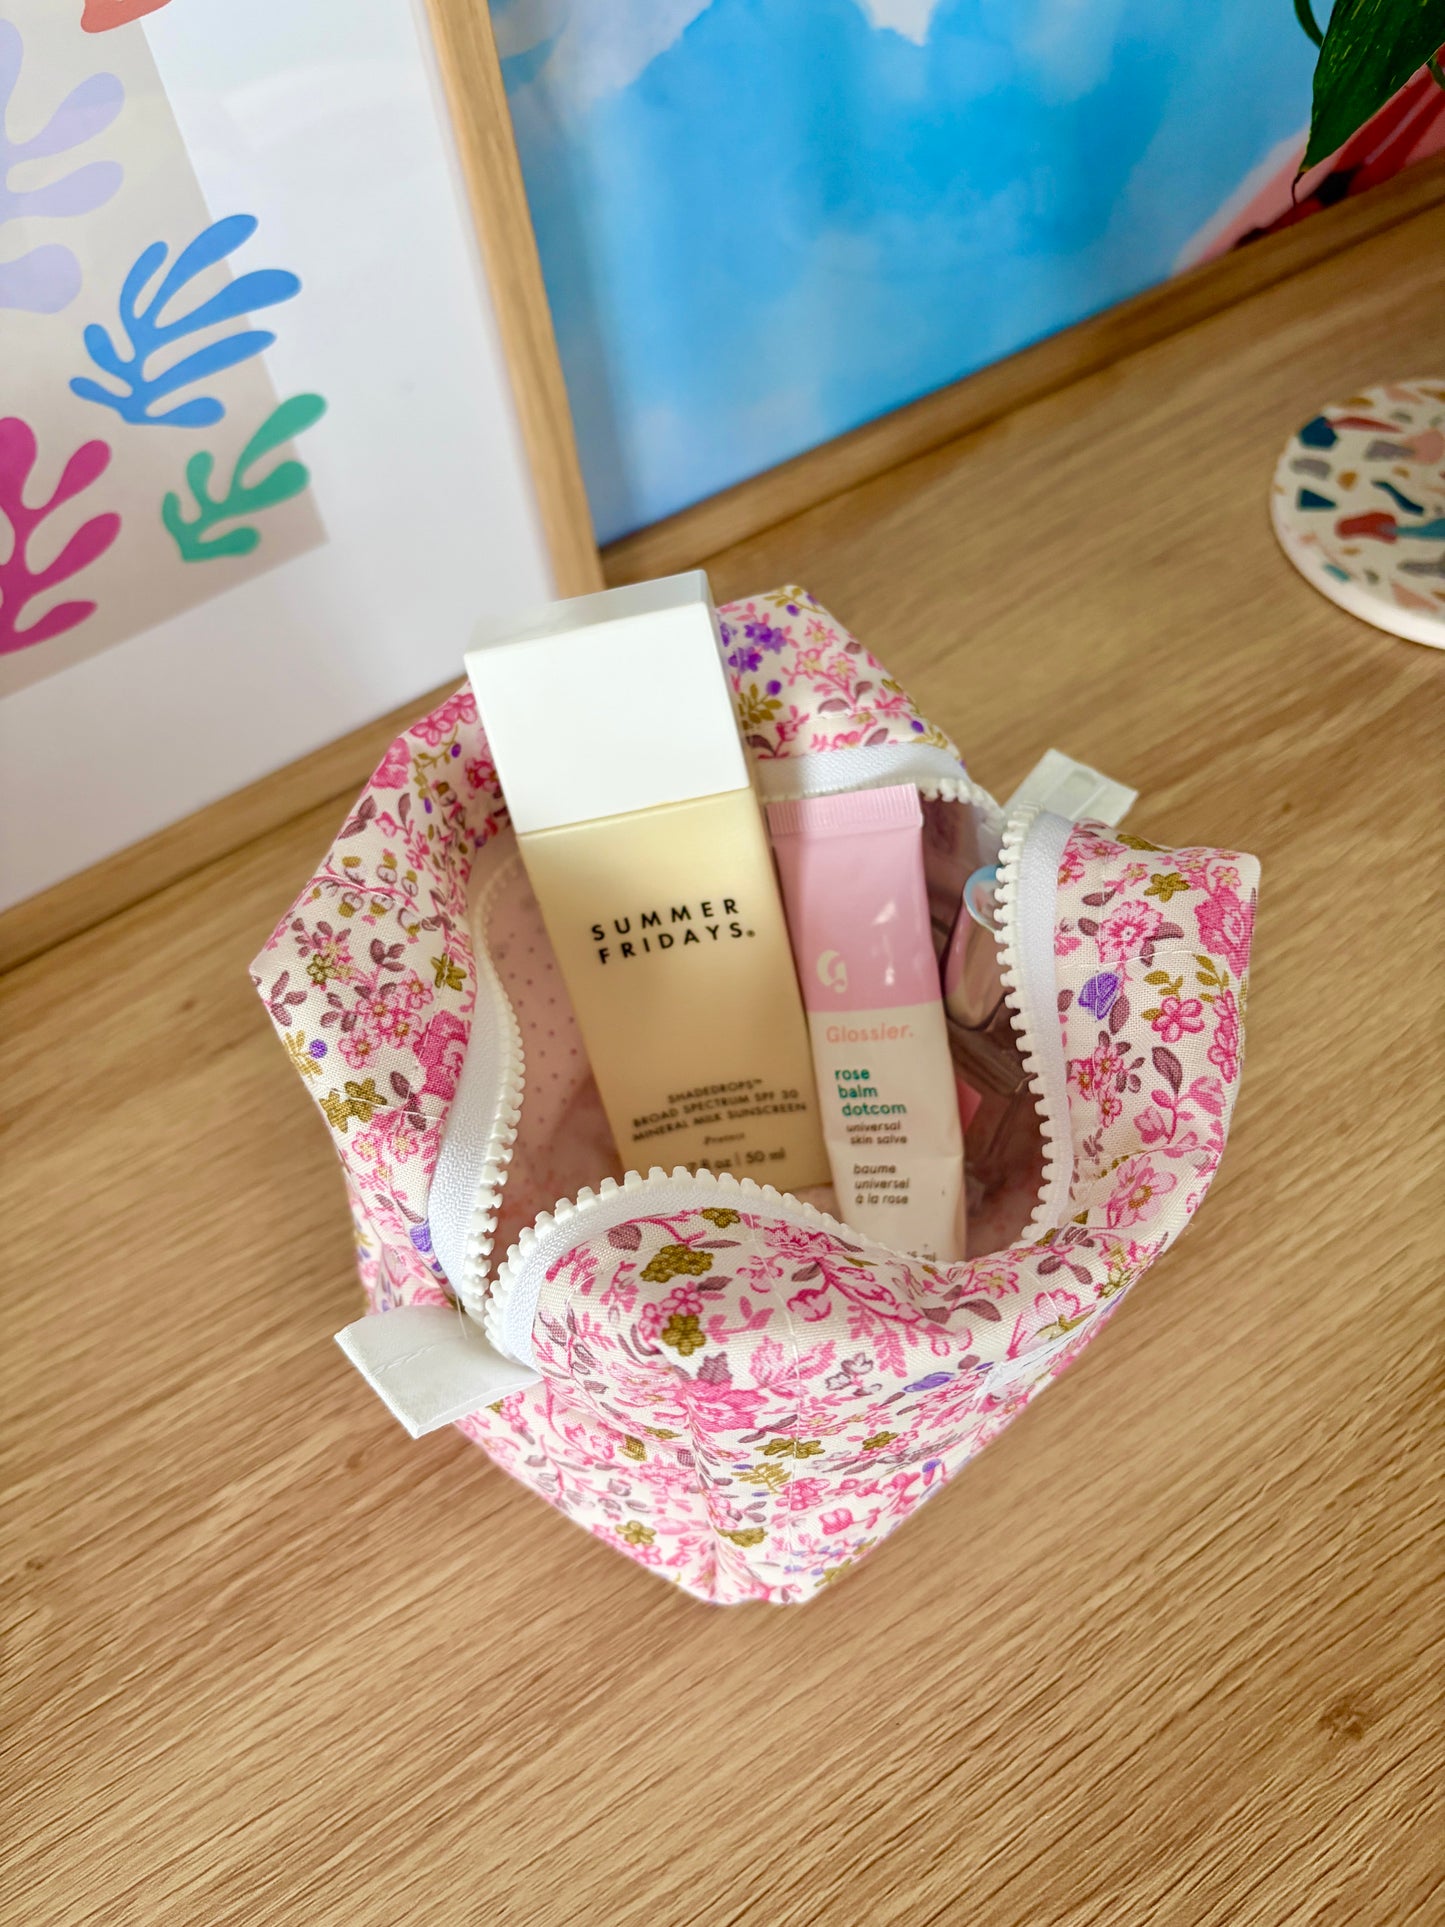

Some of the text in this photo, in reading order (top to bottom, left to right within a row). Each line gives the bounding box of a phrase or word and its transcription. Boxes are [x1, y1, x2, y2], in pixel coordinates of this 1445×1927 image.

[591, 898, 739, 941] SUMMER
[834, 1068, 870, 1081] rose
[837, 1083, 878, 1099] balm
[632, 1088, 799, 1127] BROAD SPECTRUM SPF 30
[841, 1102, 907, 1117] dotcom
[632, 1102, 808, 1142] MINERAL MILK SUNSCREEN
[846, 1121, 901, 1133] universal
[850, 1134, 908, 1145] skin salve
[714, 1158, 732, 1169] oz
[745, 1150, 766, 1165] 50
[769, 1146, 786, 1160] ml
[853, 1163, 897, 1175] baume
[854, 1178, 910, 1190] universel
[867, 1193, 879, 1204] la
[882, 1194, 909, 1205] rose
